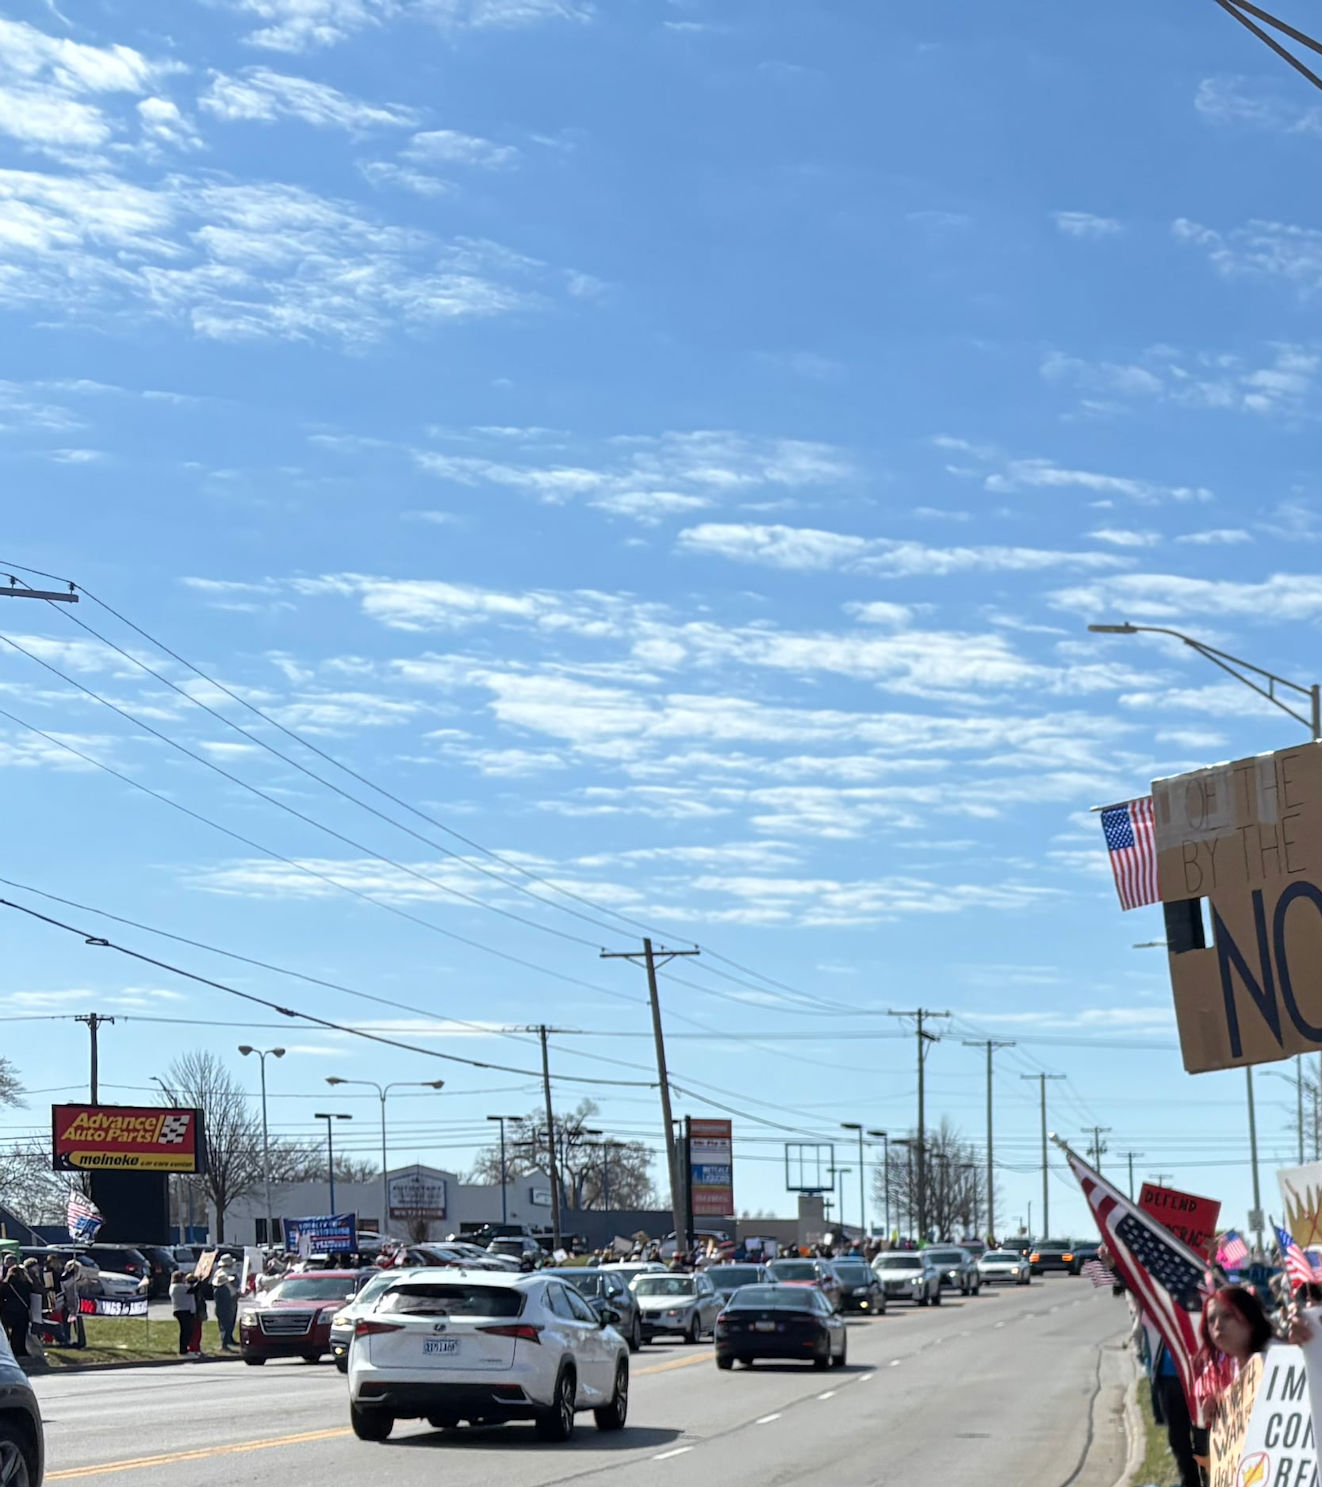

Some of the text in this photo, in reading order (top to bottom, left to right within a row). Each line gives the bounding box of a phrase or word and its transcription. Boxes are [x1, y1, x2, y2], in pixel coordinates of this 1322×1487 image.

[1234, 754, 1305, 822] THE
[1181, 813, 1307, 894] BY THE
[71, 1112, 156, 1130] Advance
[61, 1127, 153, 1143] Auto Parts
[1144, 1189, 1198, 1213] DEFEND
